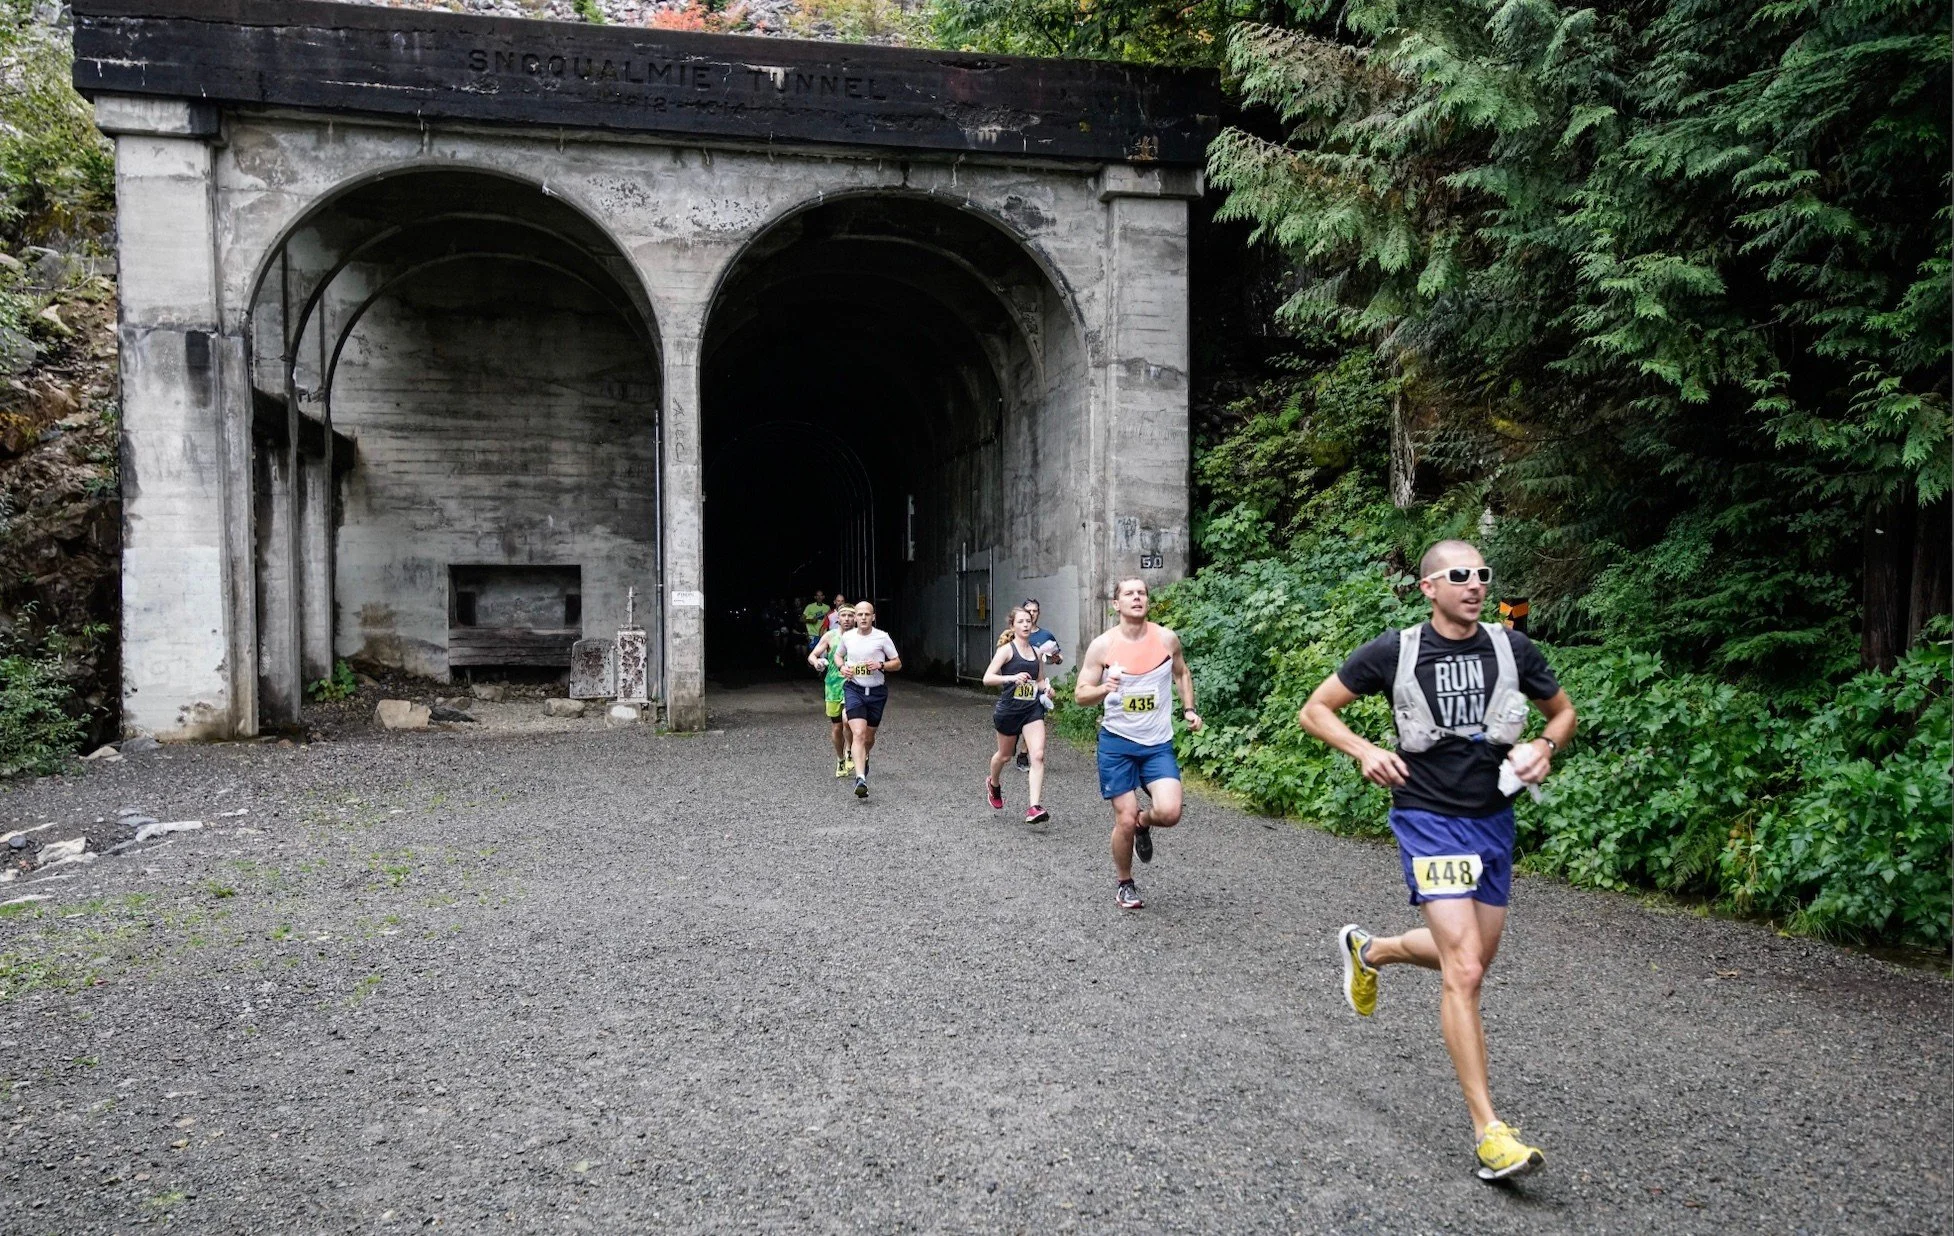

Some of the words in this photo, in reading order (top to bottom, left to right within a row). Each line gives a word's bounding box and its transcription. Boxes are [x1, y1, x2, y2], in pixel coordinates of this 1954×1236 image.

[468, 50, 711, 91] SNOQUALMIE
[747, 69, 887, 100] TUNNEL
[1434, 659, 1485, 692] RUN
[1128, 695, 1155, 711] 435
[1437, 694, 1485, 727] VAN
[1426, 860, 1473, 885] 448
